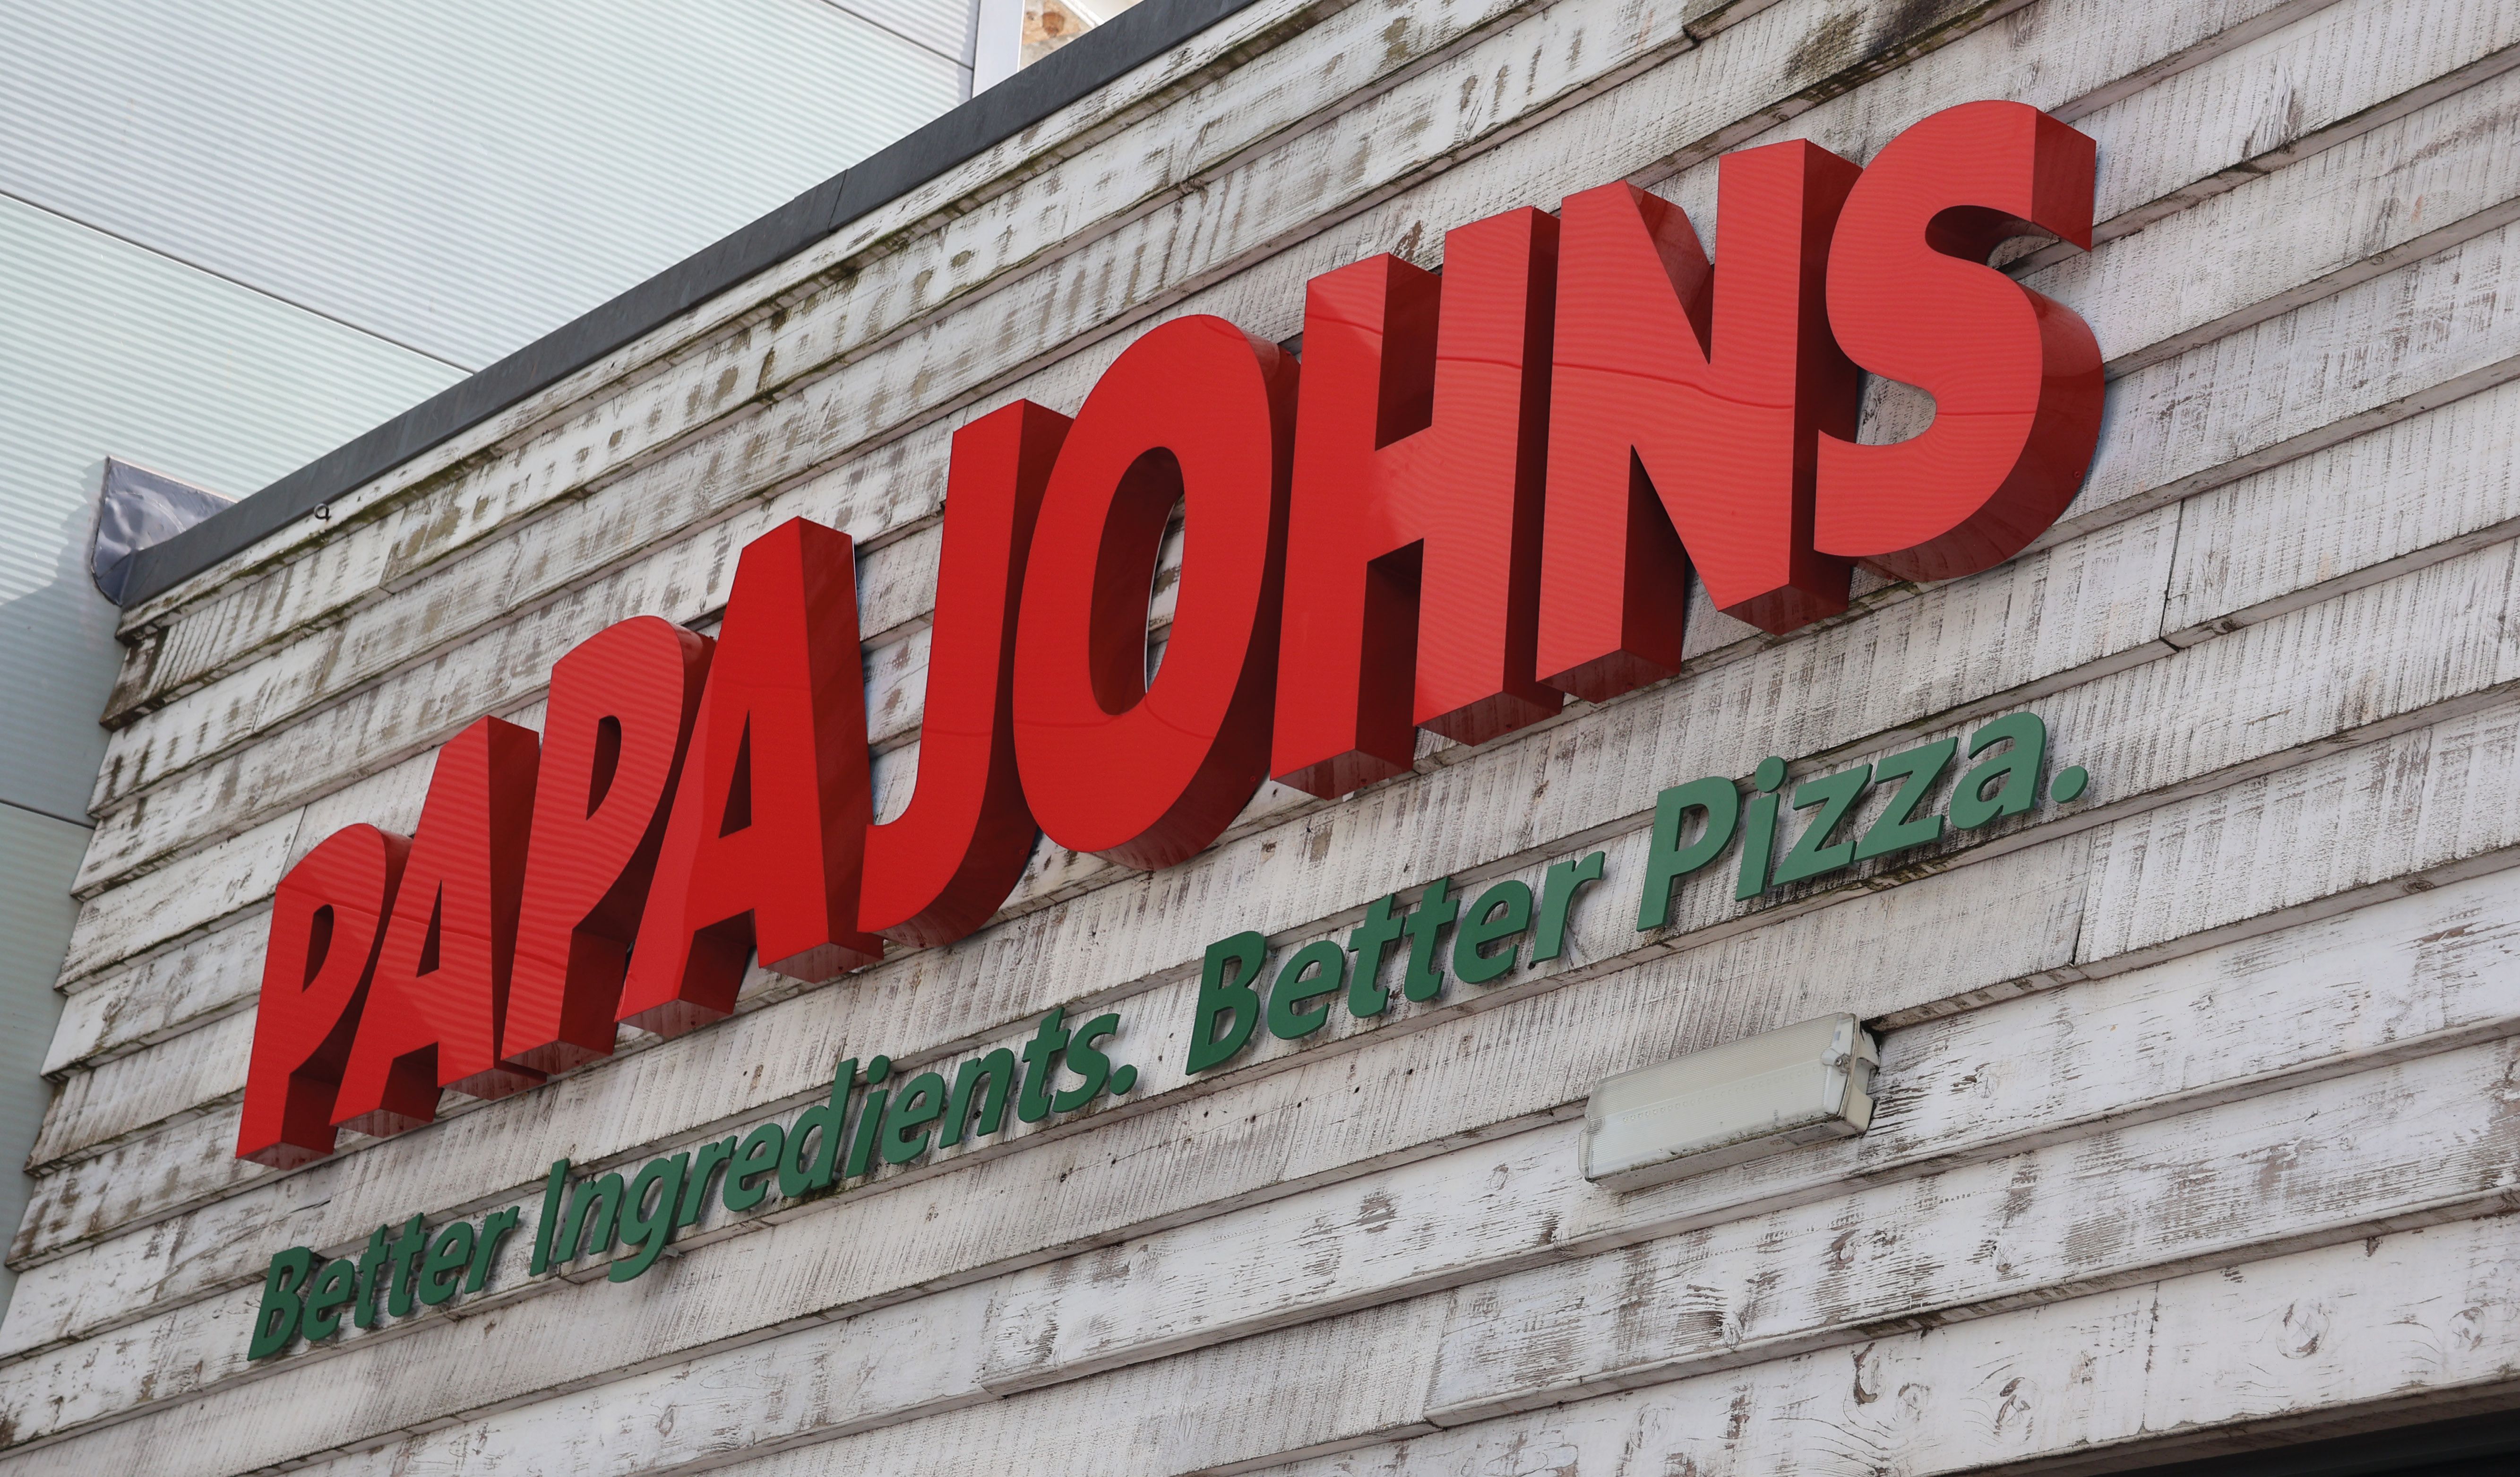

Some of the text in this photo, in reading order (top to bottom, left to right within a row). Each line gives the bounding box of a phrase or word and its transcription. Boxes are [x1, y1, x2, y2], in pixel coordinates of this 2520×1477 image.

[247, 711, 2089, 1361] Better Ingredients. Better Pizza.
